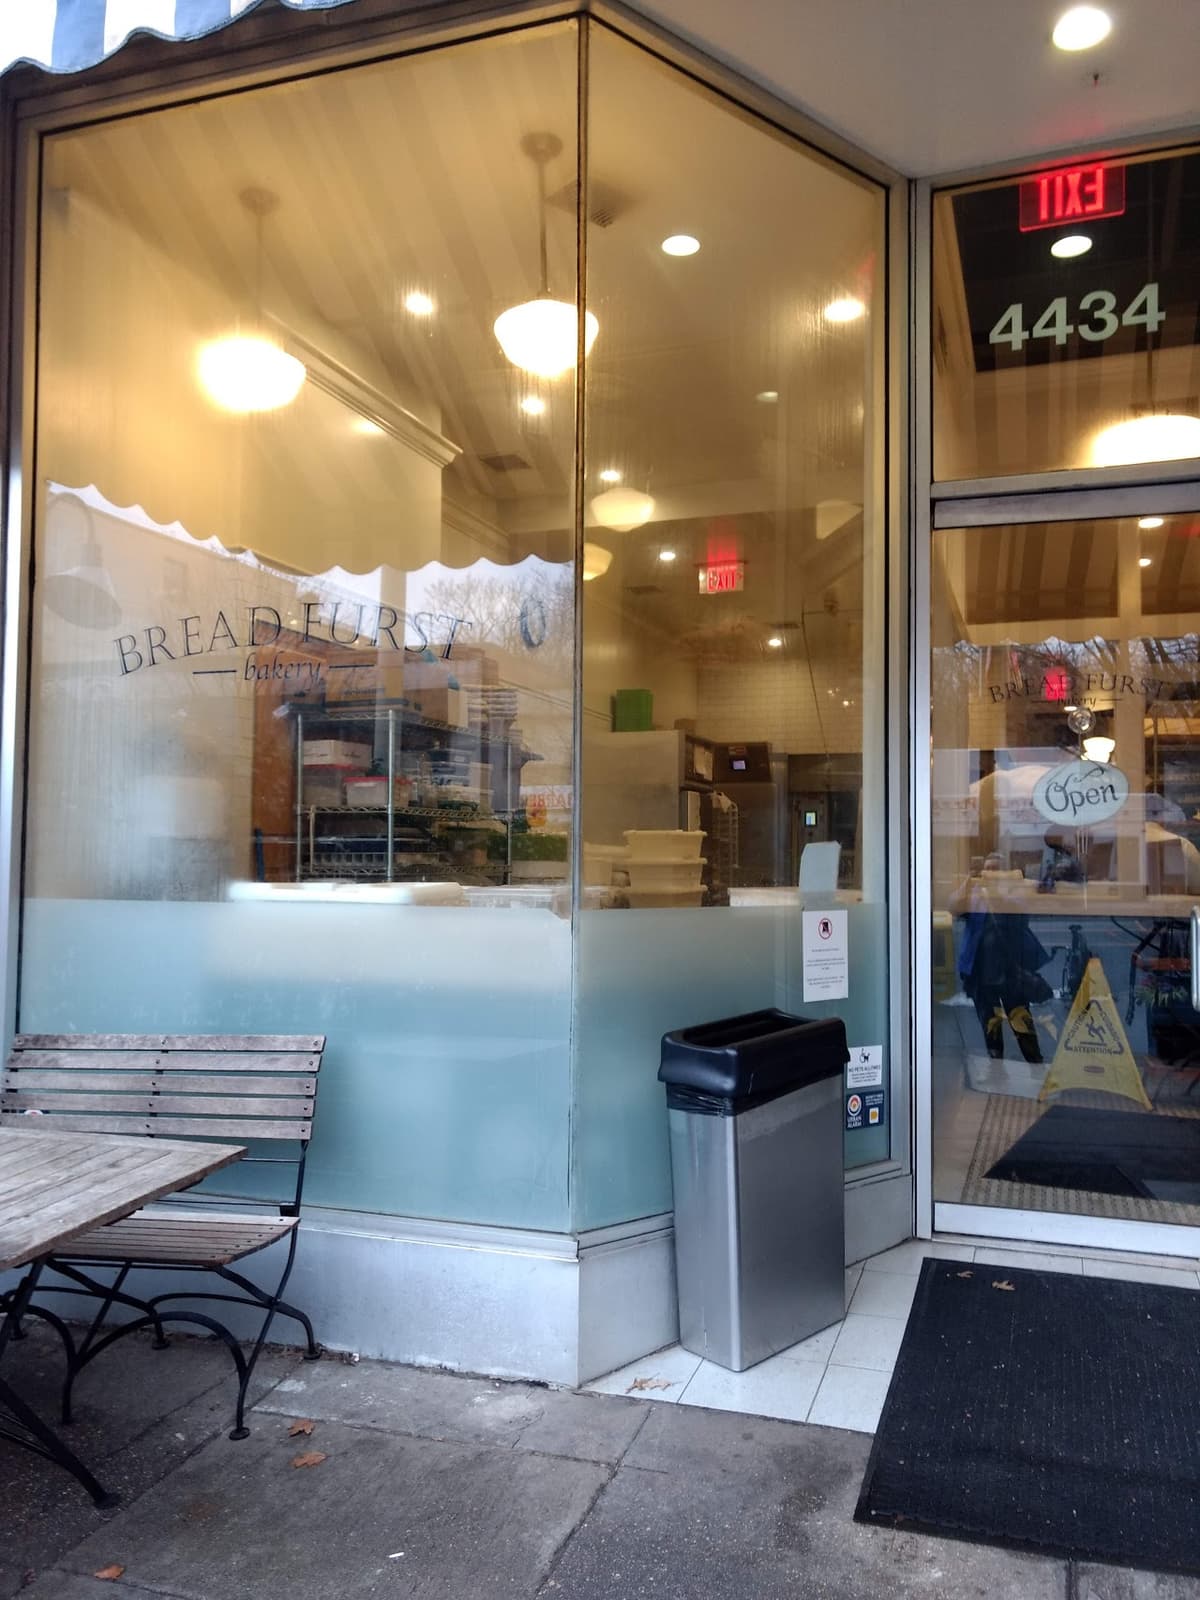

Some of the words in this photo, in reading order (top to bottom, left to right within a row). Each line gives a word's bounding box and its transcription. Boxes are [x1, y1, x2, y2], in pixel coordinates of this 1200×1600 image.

[988, 282, 1167, 352] 4434
[706, 566, 737, 593] EXIT
[113, 606, 282, 677] BREAD
[302, 602, 473, 660] FURST
[244, 651, 322, 692] bakery
[988, 673, 1076, 704] BREAD
[1086, 673, 1171, 699] FURST
[1044, 766, 1119, 817] Open
